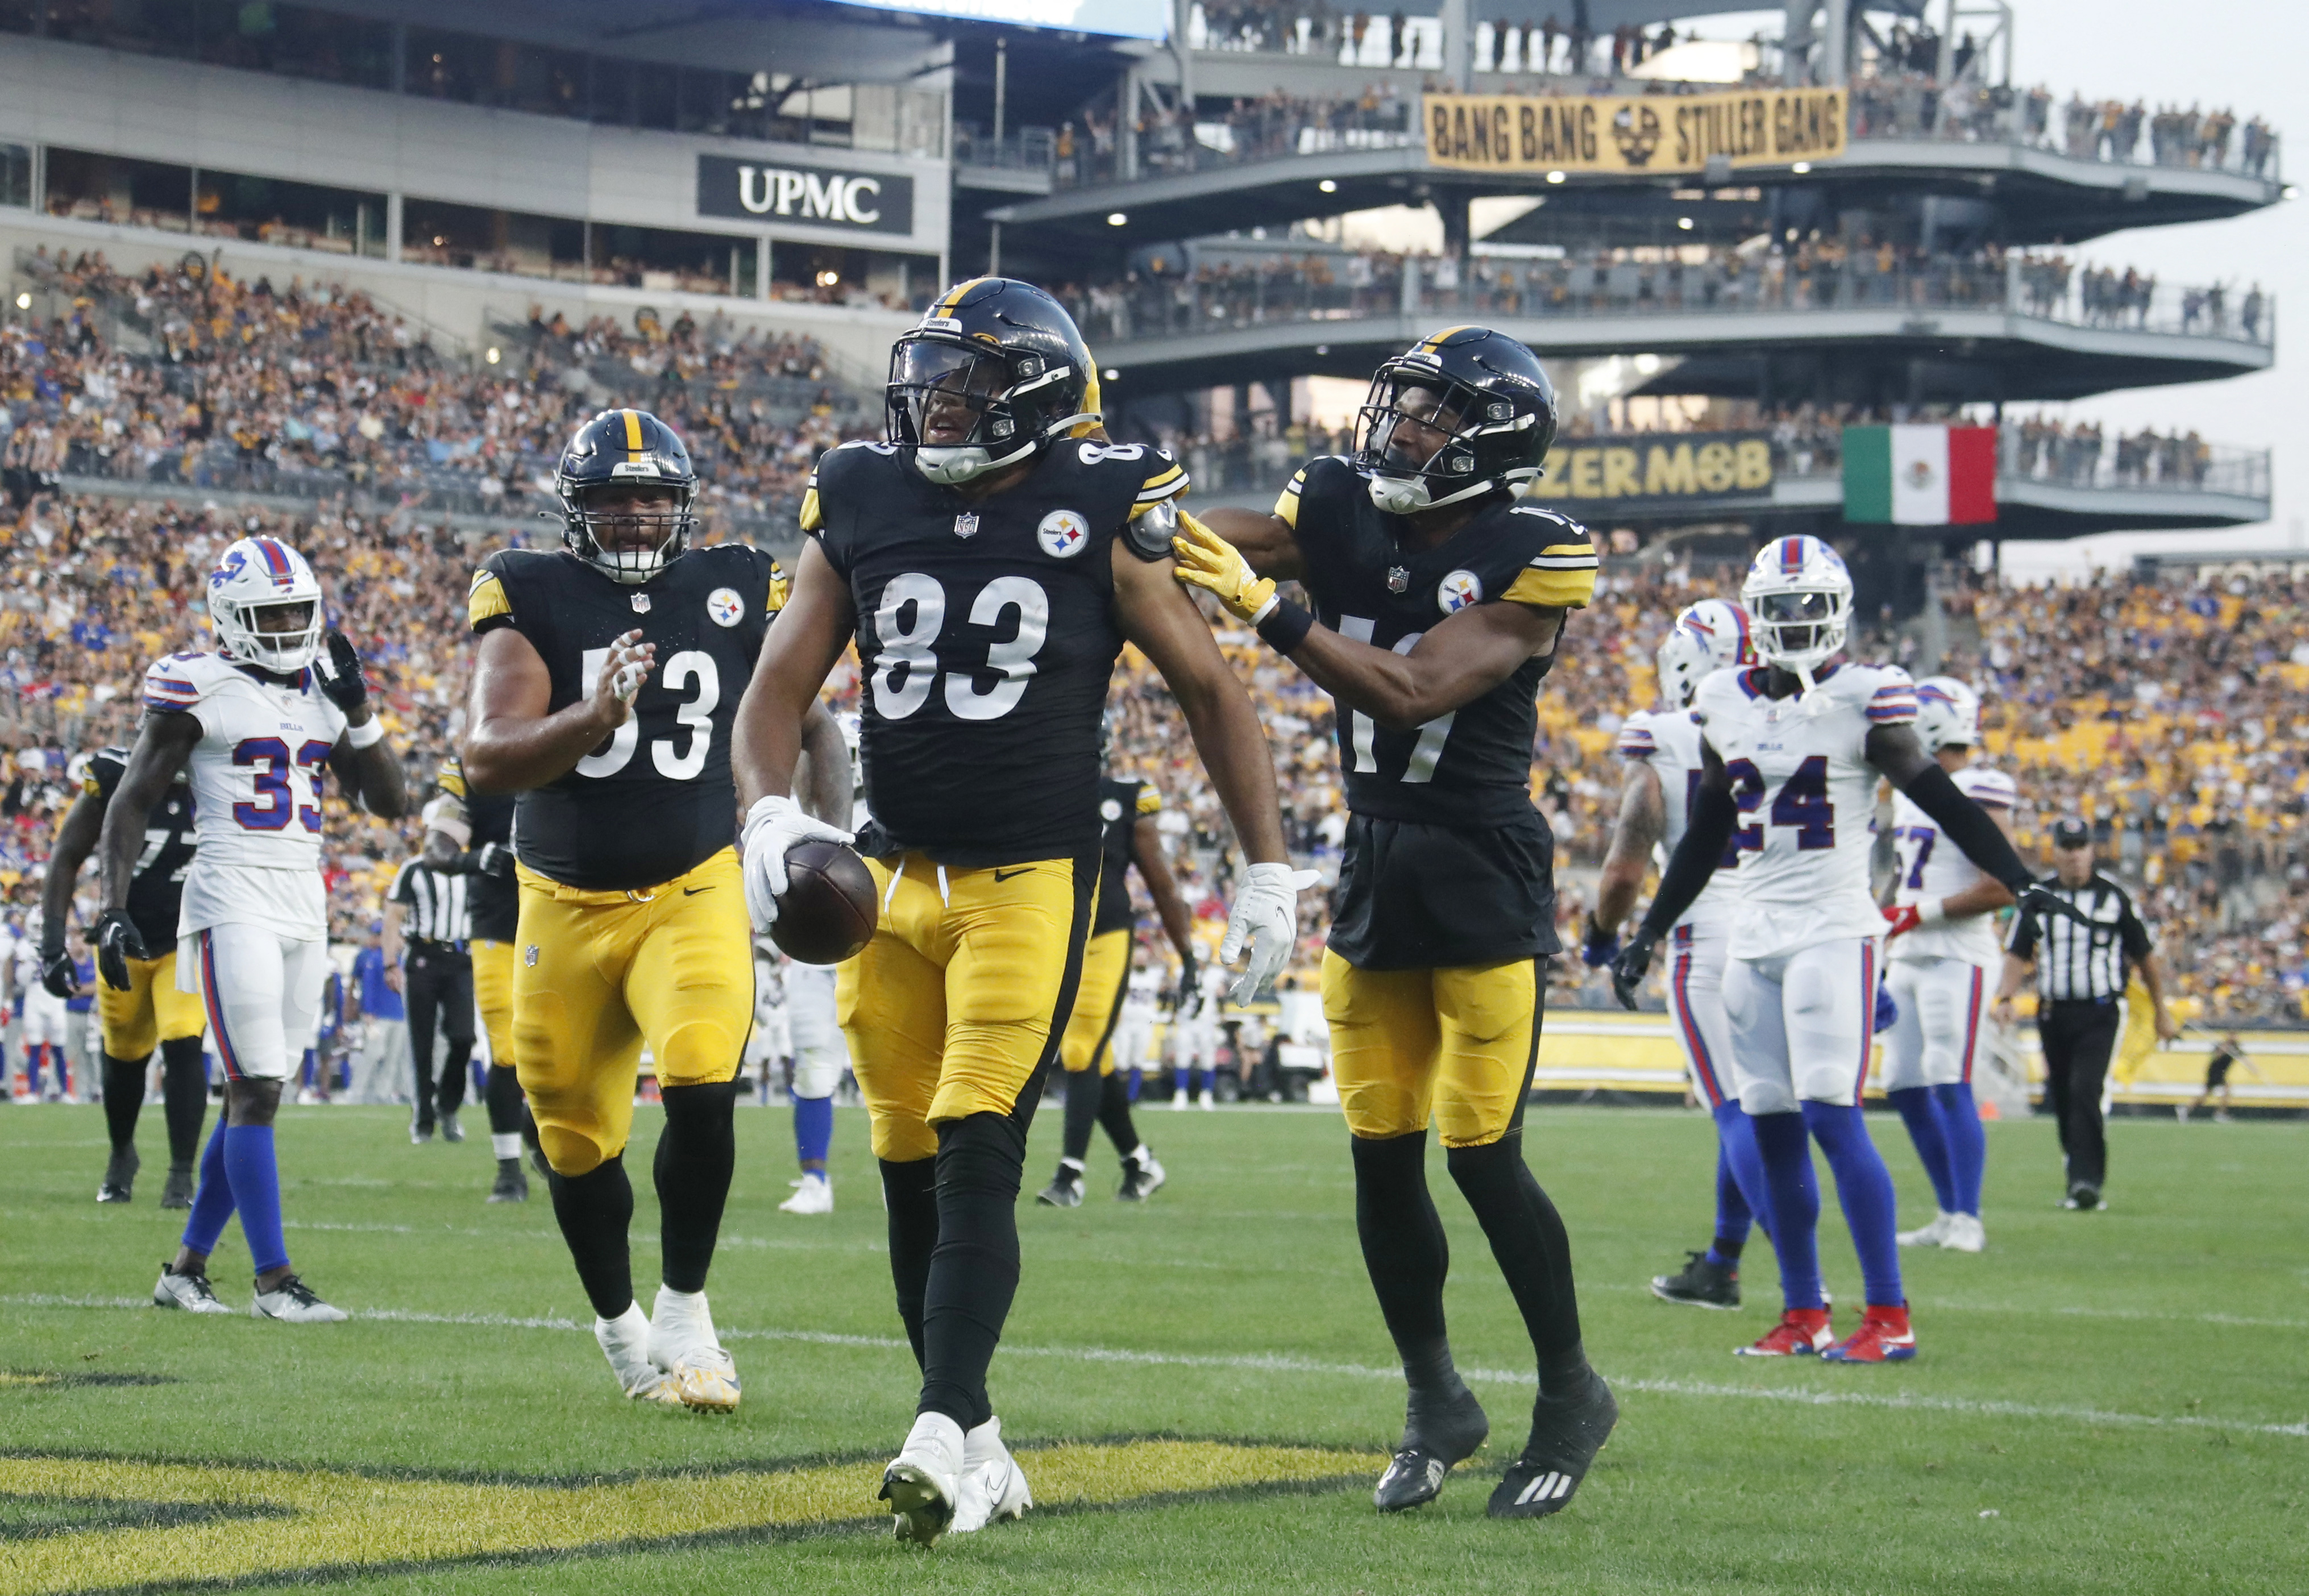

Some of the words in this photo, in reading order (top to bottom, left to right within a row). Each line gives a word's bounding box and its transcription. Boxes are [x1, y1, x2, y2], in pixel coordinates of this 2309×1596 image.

[1432, 104, 1511, 163] BANG
[1520, 105, 1597, 163] BANG
[1675, 98, 1767, 165] STILLER
[1775, 93, 1841, 155] GANG
[738, 167, 881, 224] UPMC
[926, 319, 950, 328] Steelers
[957, 523, 974, 533] NFL
[870, 572, 1049, 720] 83
[279, 722, 304, 732] BILLS
